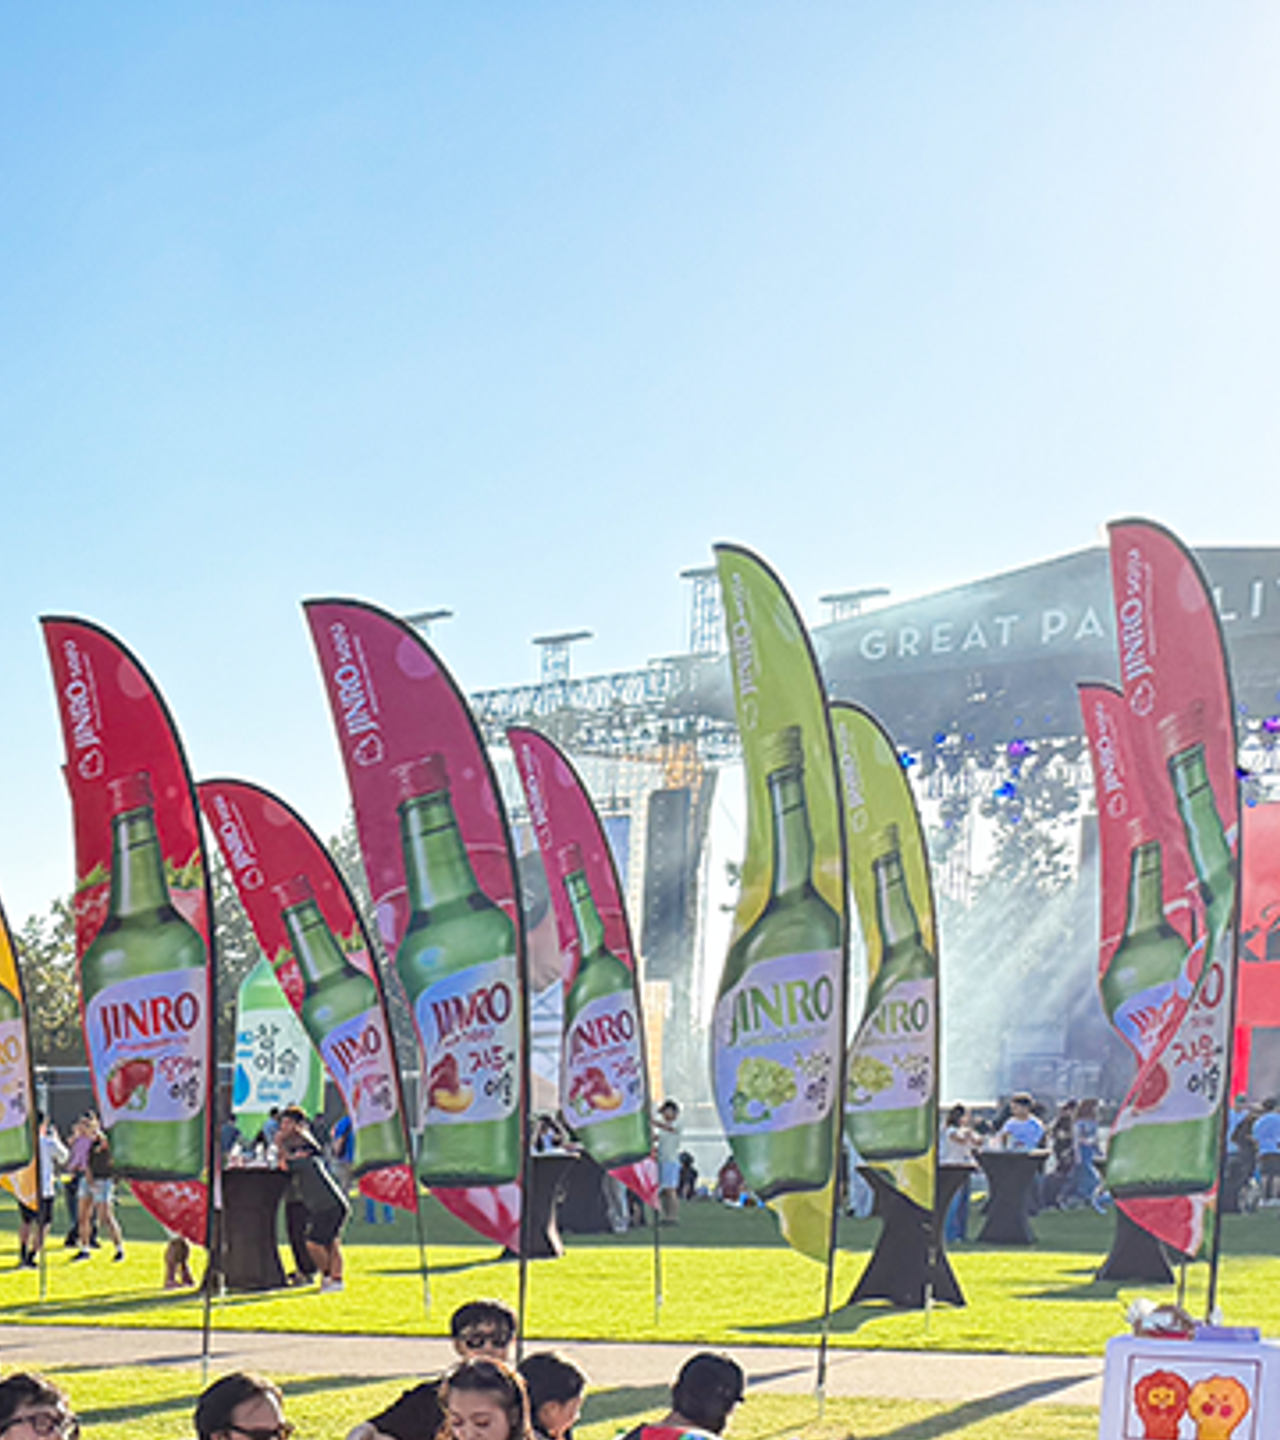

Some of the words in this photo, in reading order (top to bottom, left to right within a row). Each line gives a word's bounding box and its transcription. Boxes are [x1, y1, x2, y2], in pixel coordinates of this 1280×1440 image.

[860, 614, 1020, 660] GREAT
[1041, 606, 1106, 645] PA
[1119, 599, 1153, 680] JINRO
[65, 680, 102, 749] JINRO
[333, 664, 378, 736] JINRO
[220, 821, 256, 869] JINRO
[100, 991, 200, 1053] JINRO
[432, 981, 511, 1043] JINRO
[728, 974, 834, 1047] JINRO
